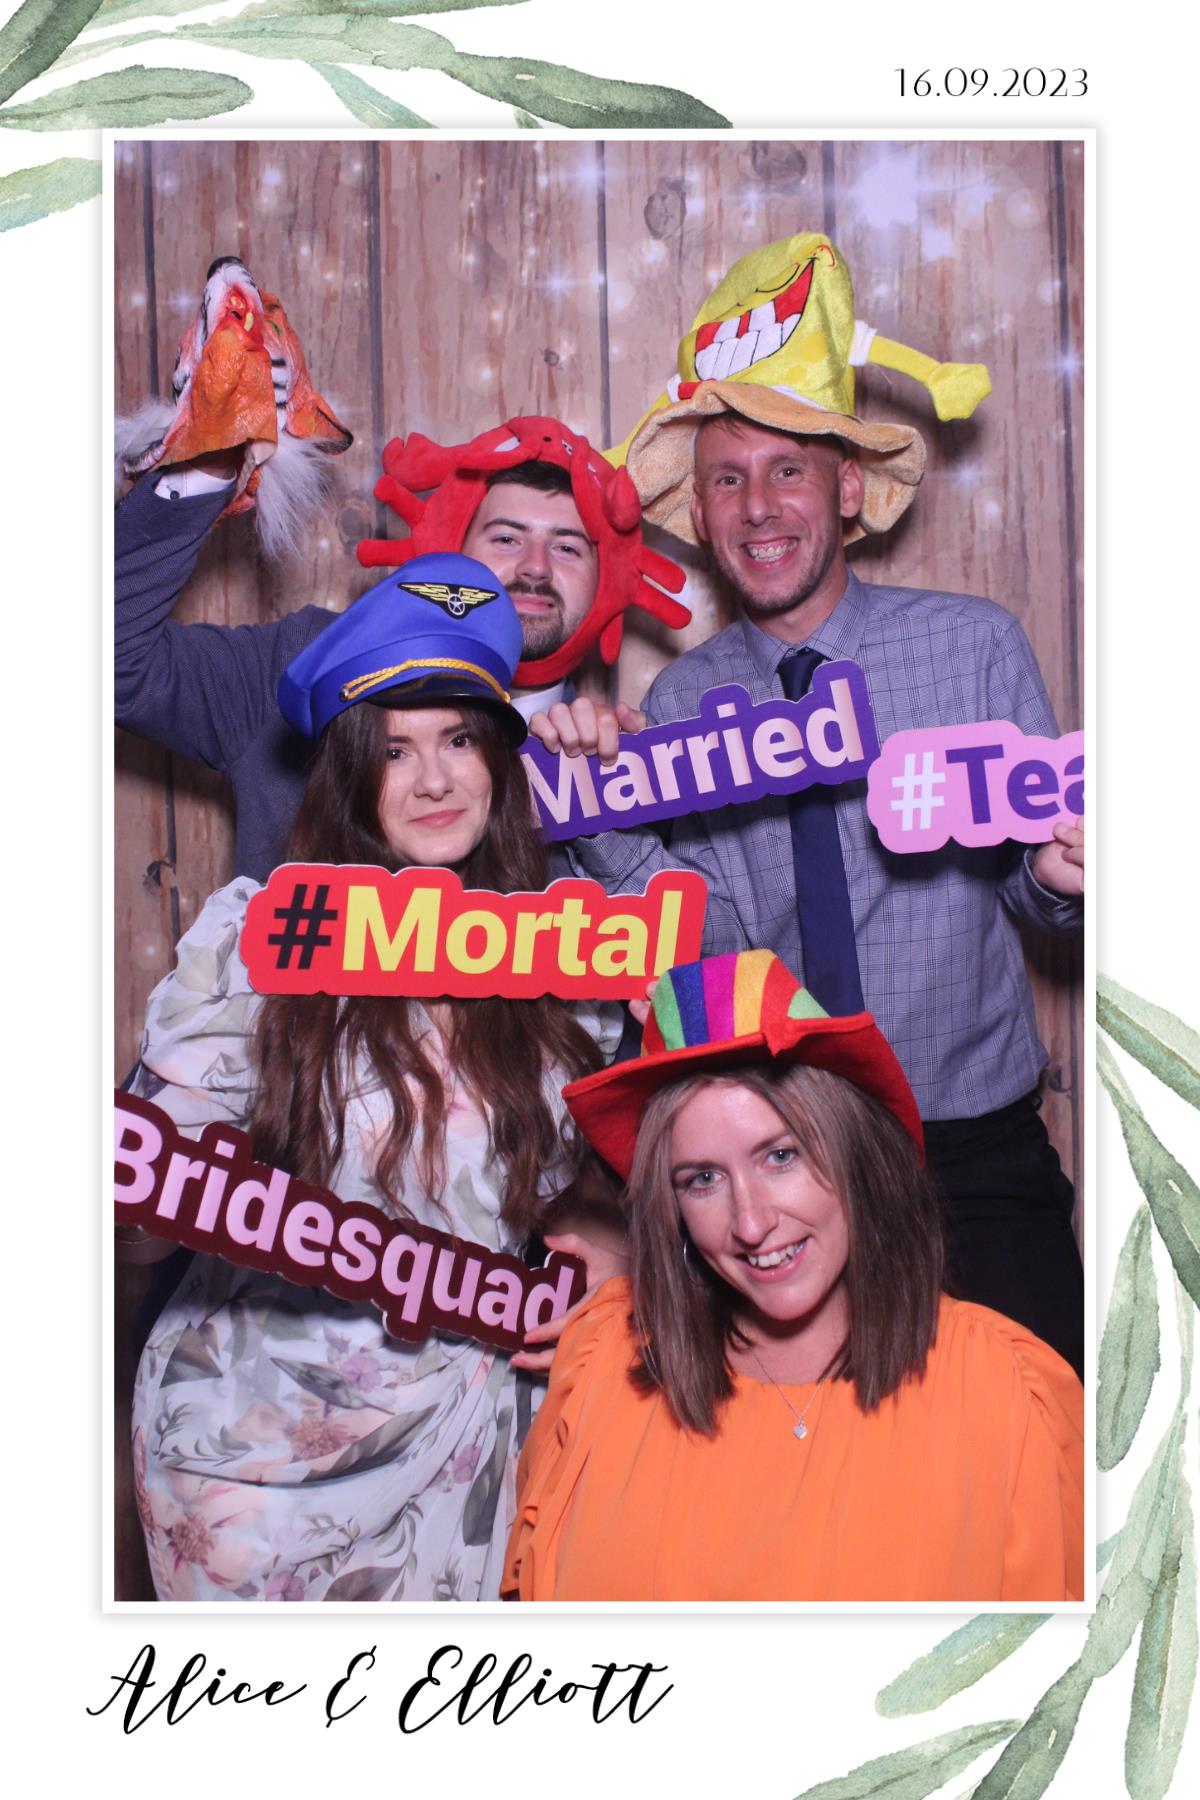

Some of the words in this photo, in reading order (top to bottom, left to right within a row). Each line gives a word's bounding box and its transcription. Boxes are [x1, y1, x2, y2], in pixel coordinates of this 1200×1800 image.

[518, 678, 865, 829] Married
[267, 883, 683, 977] #Mortal
[114, 1106, 575, 1334] Bridesquad
